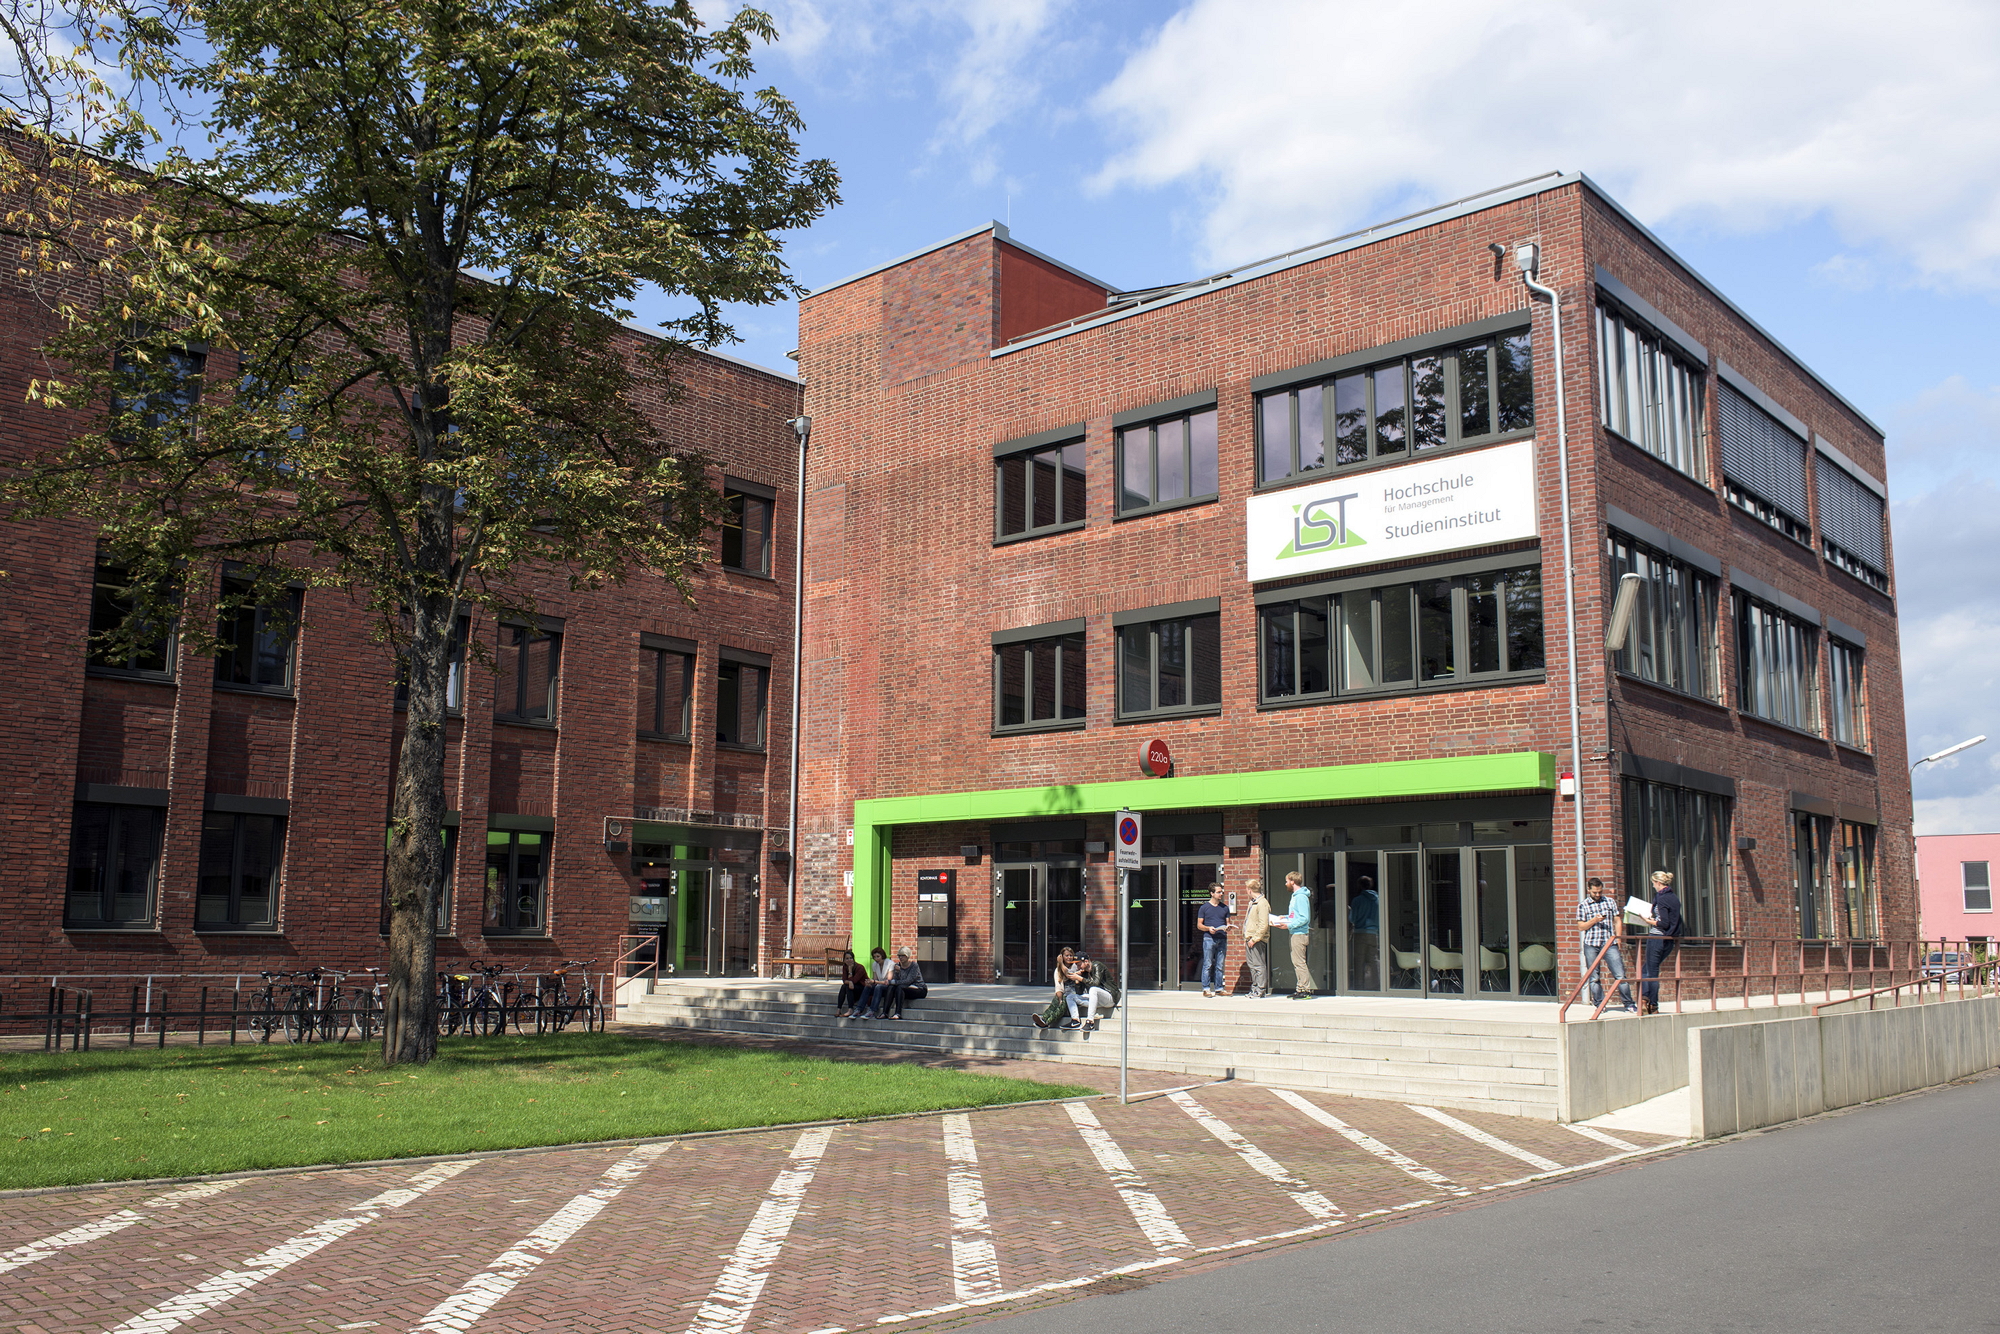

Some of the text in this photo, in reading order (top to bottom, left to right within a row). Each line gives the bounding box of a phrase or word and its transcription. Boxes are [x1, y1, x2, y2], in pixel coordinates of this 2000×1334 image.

[1384, 473, 1474, 502] Hochschule
[1384, 495, 1454, 514] für Management
[1385, 508, 1502, 540] Studieninstitut
[1150, 750, 1168, 764] 220a
